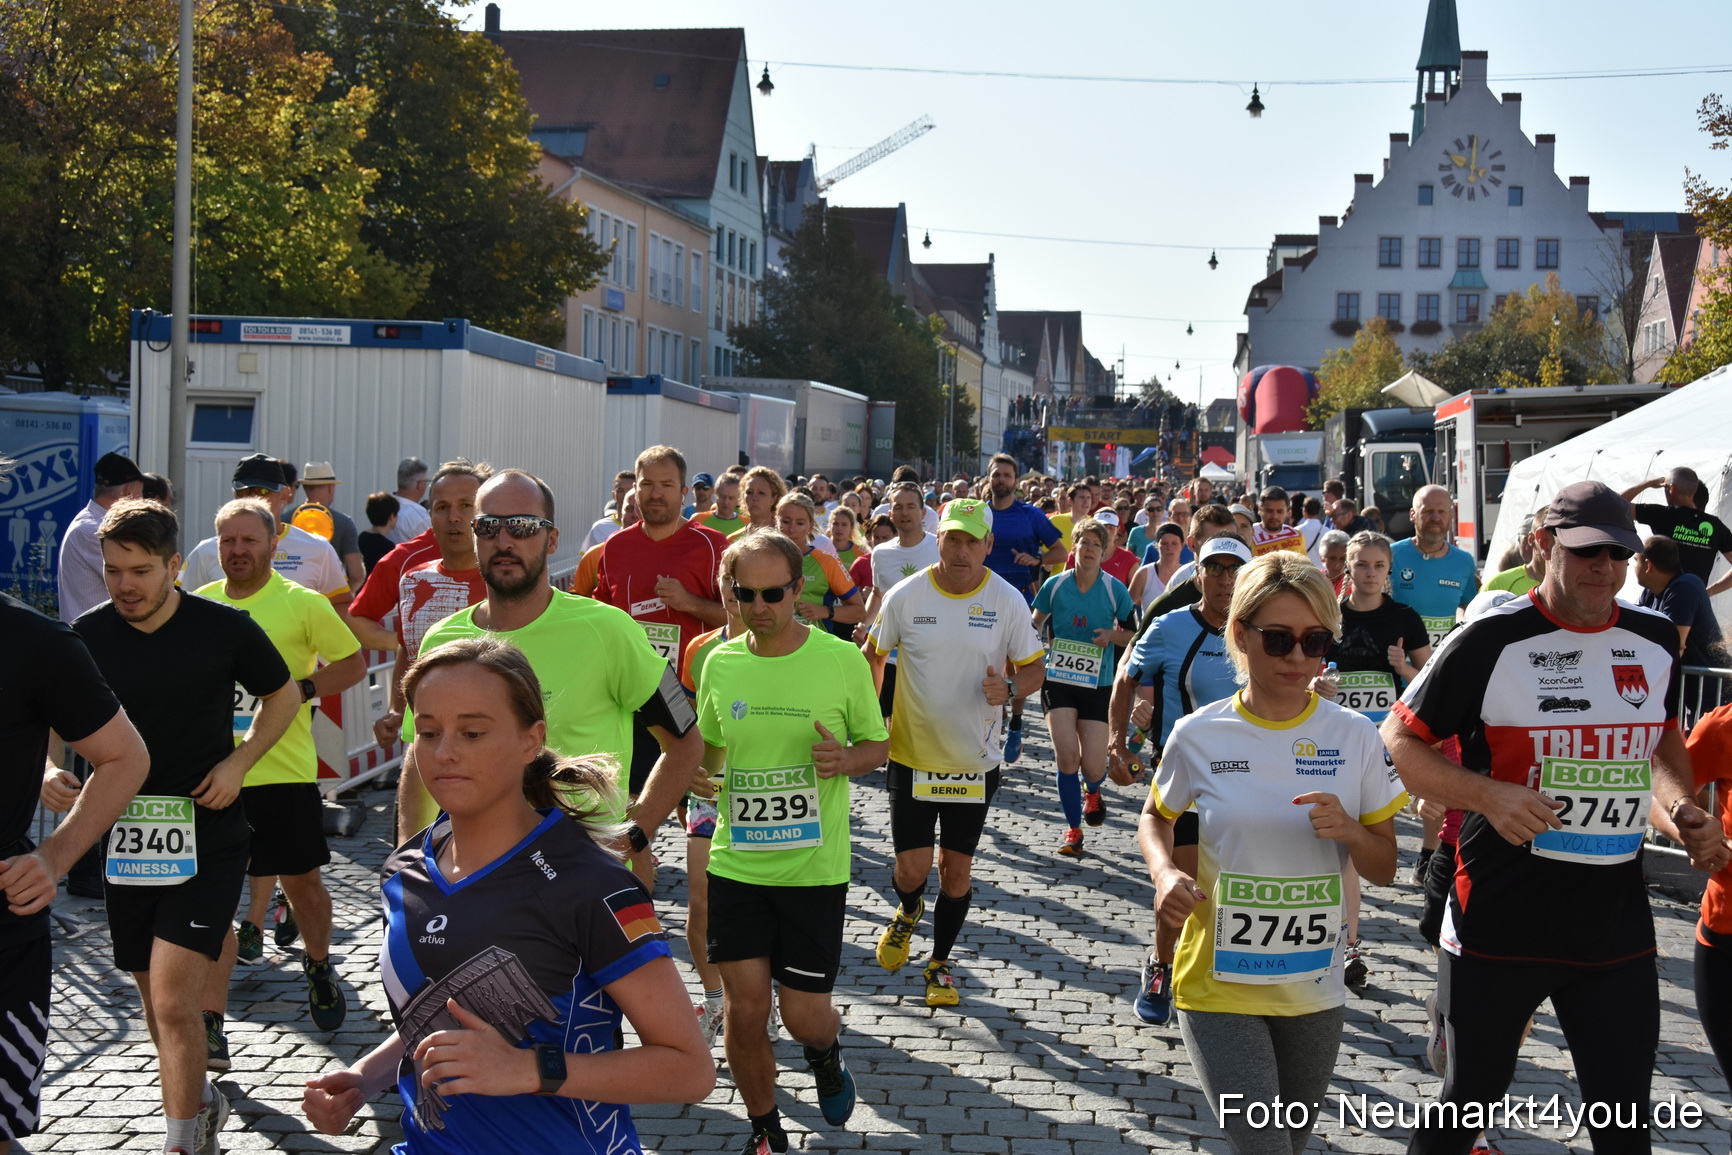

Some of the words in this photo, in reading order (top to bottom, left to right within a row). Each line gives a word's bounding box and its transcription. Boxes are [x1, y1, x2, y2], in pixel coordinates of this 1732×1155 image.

[15, 418, 39, 429] 08141
[45, 419, 60, 431] 536
[61, 422, 72, 431] 80
[1084, 431, 1122, 441] START
[1673, 525, 1699, 536] physio
[1672, 532, 1710, 545] neumarkt
[1439, 579, 1460, 588] BOCK
[641, 602, 657, 611] DEHN
[970, 606, 983, 616] 20
[1422, 618, 1452, 630] OCK
[1057, 641, 1099, 657] BOCK
[1611, 648, 1636, 658] kalas
[1055, 654, 1095, 673] 2462
[1056, 671, 1091, 683] MELANIE
[1538, 676, 1583, 685] XconCept
[1337, 691, 1389, 709] 2676
[1295, 743, 1316, 757] 20
[1211, 761, 1249, 771] BOCK
[1296, 758, 1346, 767] Neumarkter
[1296, 768, 1337, 776] Stadtlauf
[1551, 761, 1645, 787] BOCK
[733, 768, 809, 790] BOCK
[931, 786, 967, 795] BERND
[119, 800, 187, 819] OCK
[736, 794, 809, 822] 2239
[1554, 795, 1641, 828] 2747
[115, 827, 184, 854] 2340
[746, 828, 803, 841] ROLAND
[1561, 836, 1626, 856] VOLKER
[117, 862, 181, 874] VANESSA
[529, 850, 557, 881] Nessa
[1227, 877, 1333, 905] BOCK
[1230, 912, 1329, 947] 2745
[419, 934, 446, 945] artiva
[1237, 959, 1287, 970] ANNA
